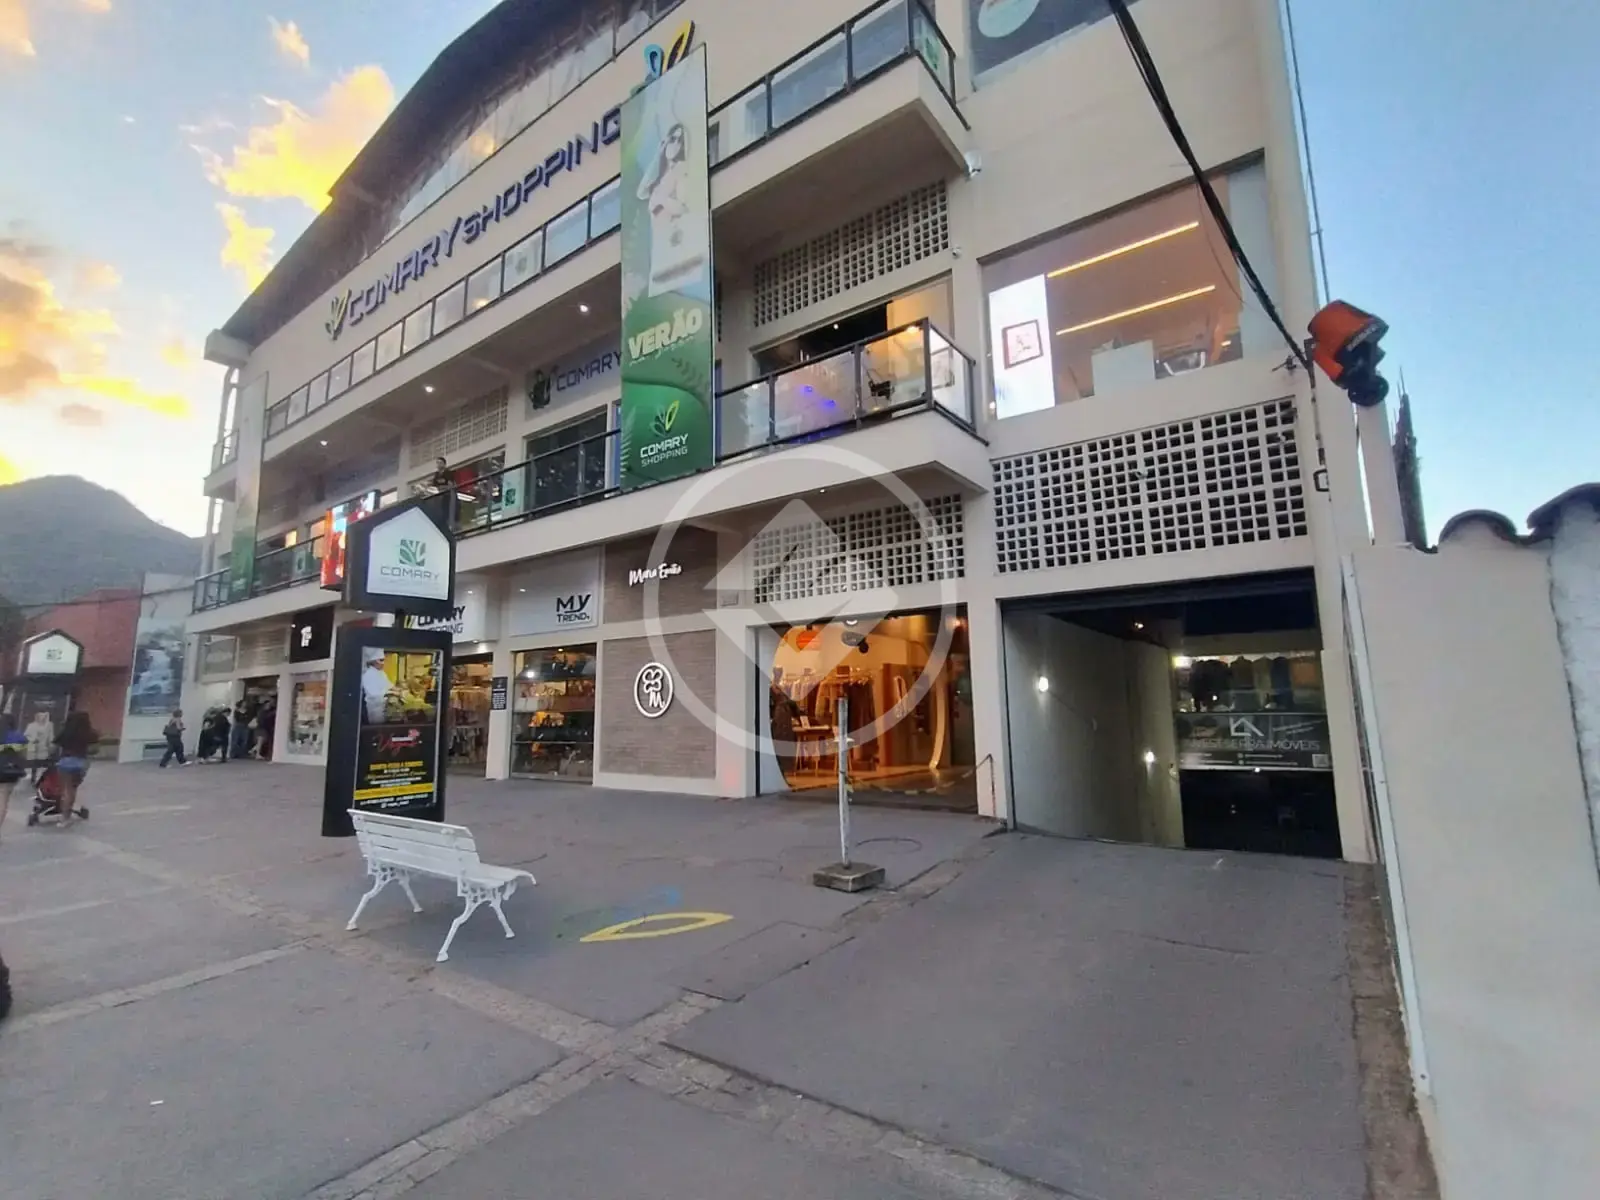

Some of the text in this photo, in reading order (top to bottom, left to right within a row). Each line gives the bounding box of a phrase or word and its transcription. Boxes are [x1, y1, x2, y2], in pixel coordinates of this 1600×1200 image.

[349, 107, 621, 327] COMARY SHOPPING
[628, 307, 703, 359] VERÃO
[640, 433, 689, 458] COMARY
[641, 446, 688, 467] SHOPPING
[380, 565, 440, 580] COMARY
